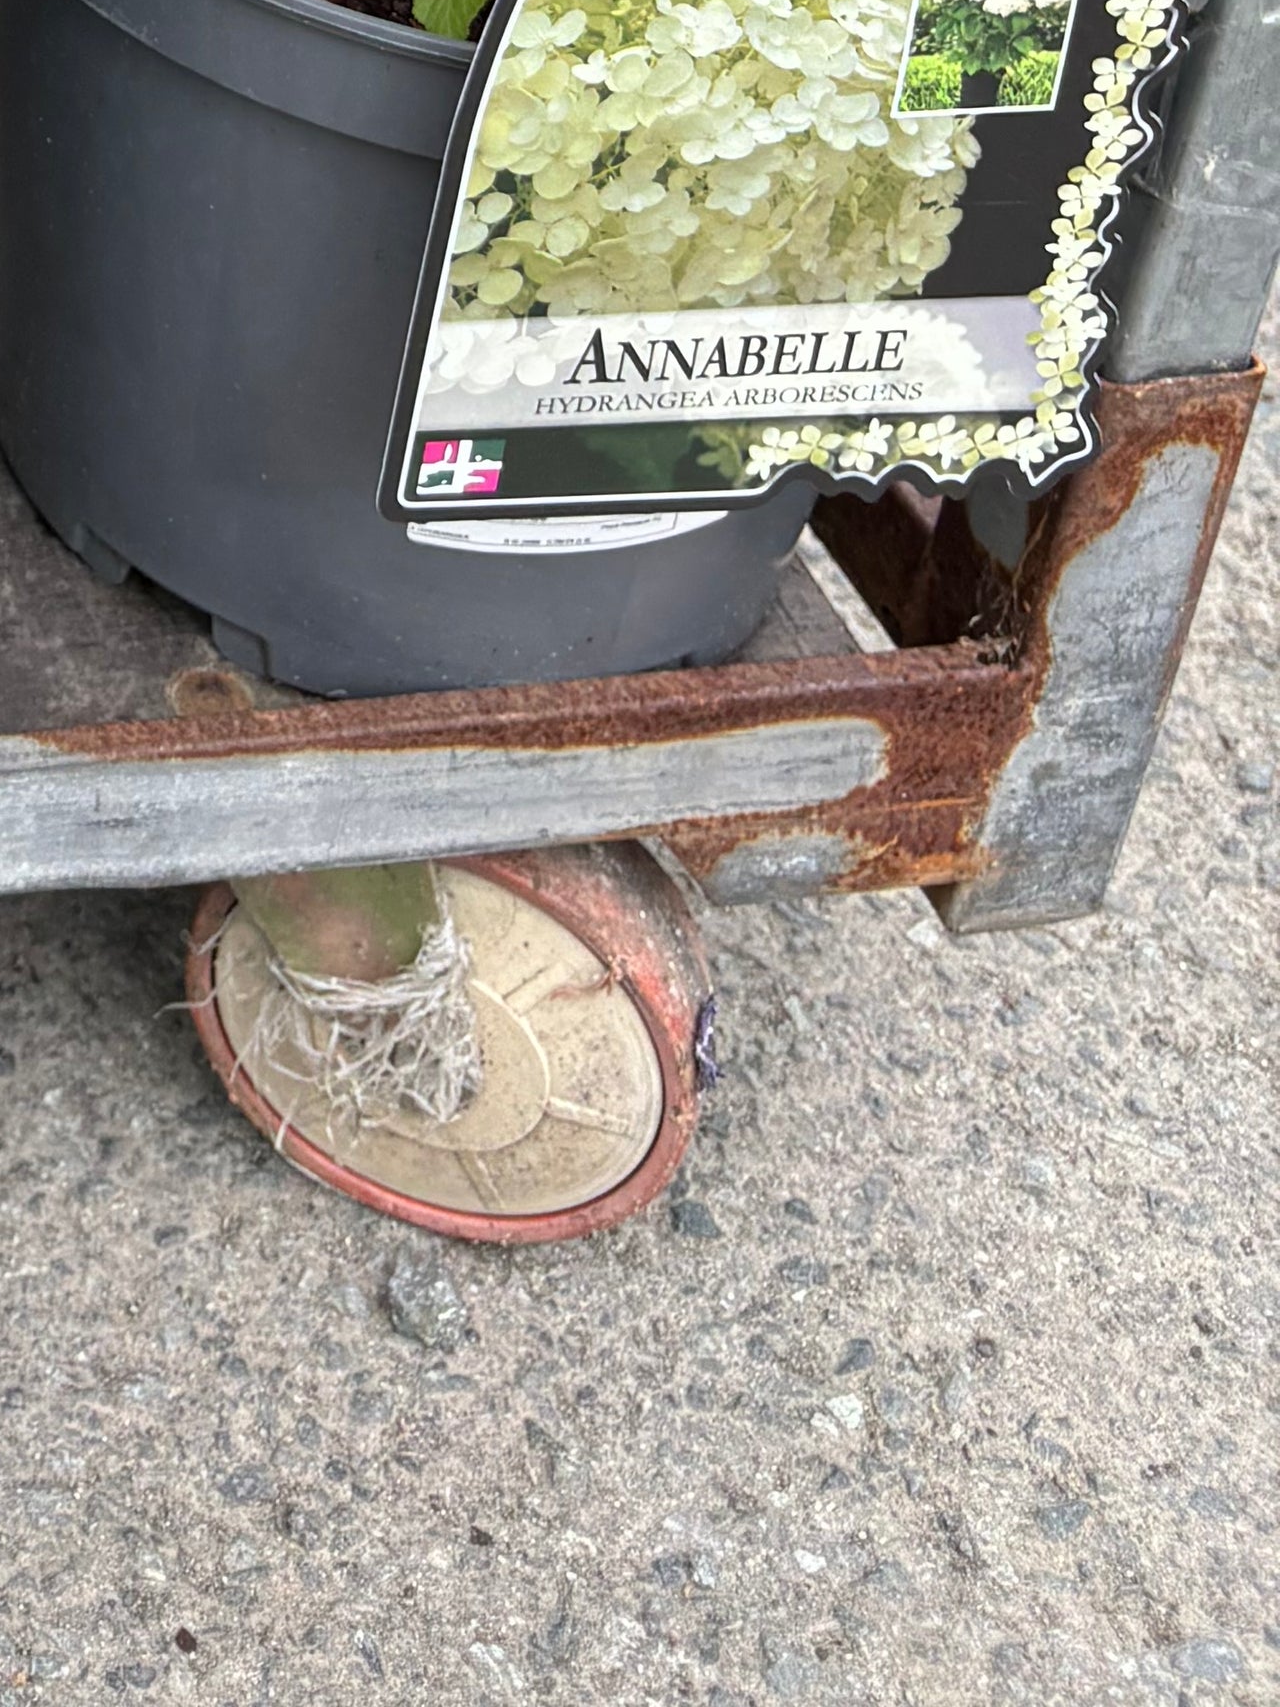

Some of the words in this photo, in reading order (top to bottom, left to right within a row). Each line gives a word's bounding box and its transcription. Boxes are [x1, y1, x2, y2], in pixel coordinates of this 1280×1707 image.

[563, 328, 908, 385] ANNABELLE
[534, 389, 716, 416] HYDRANGEA
[723, 381, 924, 407] ARBORESCENS
